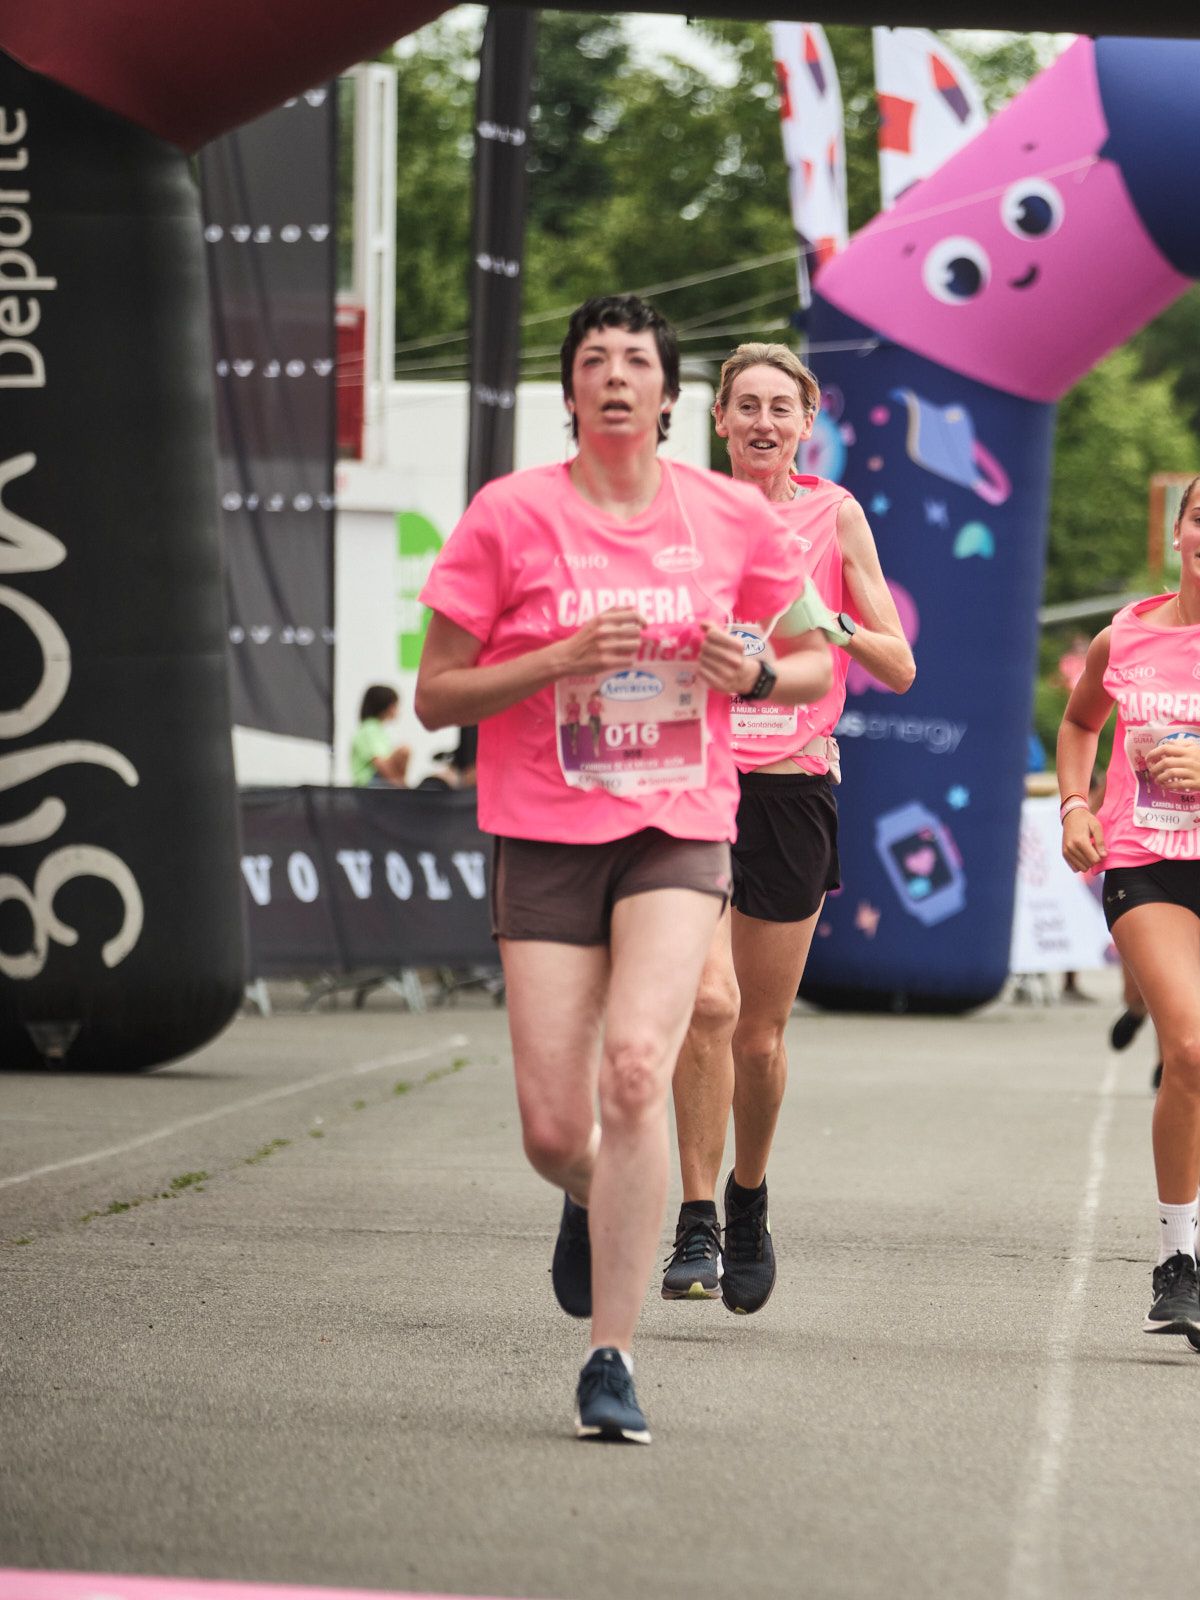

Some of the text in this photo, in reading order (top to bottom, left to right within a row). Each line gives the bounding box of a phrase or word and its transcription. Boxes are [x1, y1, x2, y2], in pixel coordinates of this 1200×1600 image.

[747, 720, 783, 729] Santander
[605, 723, 660, 748] 016
[1145, 812, 1180, 825] OYSHO
[336, 849, 486, 901] VOLV
